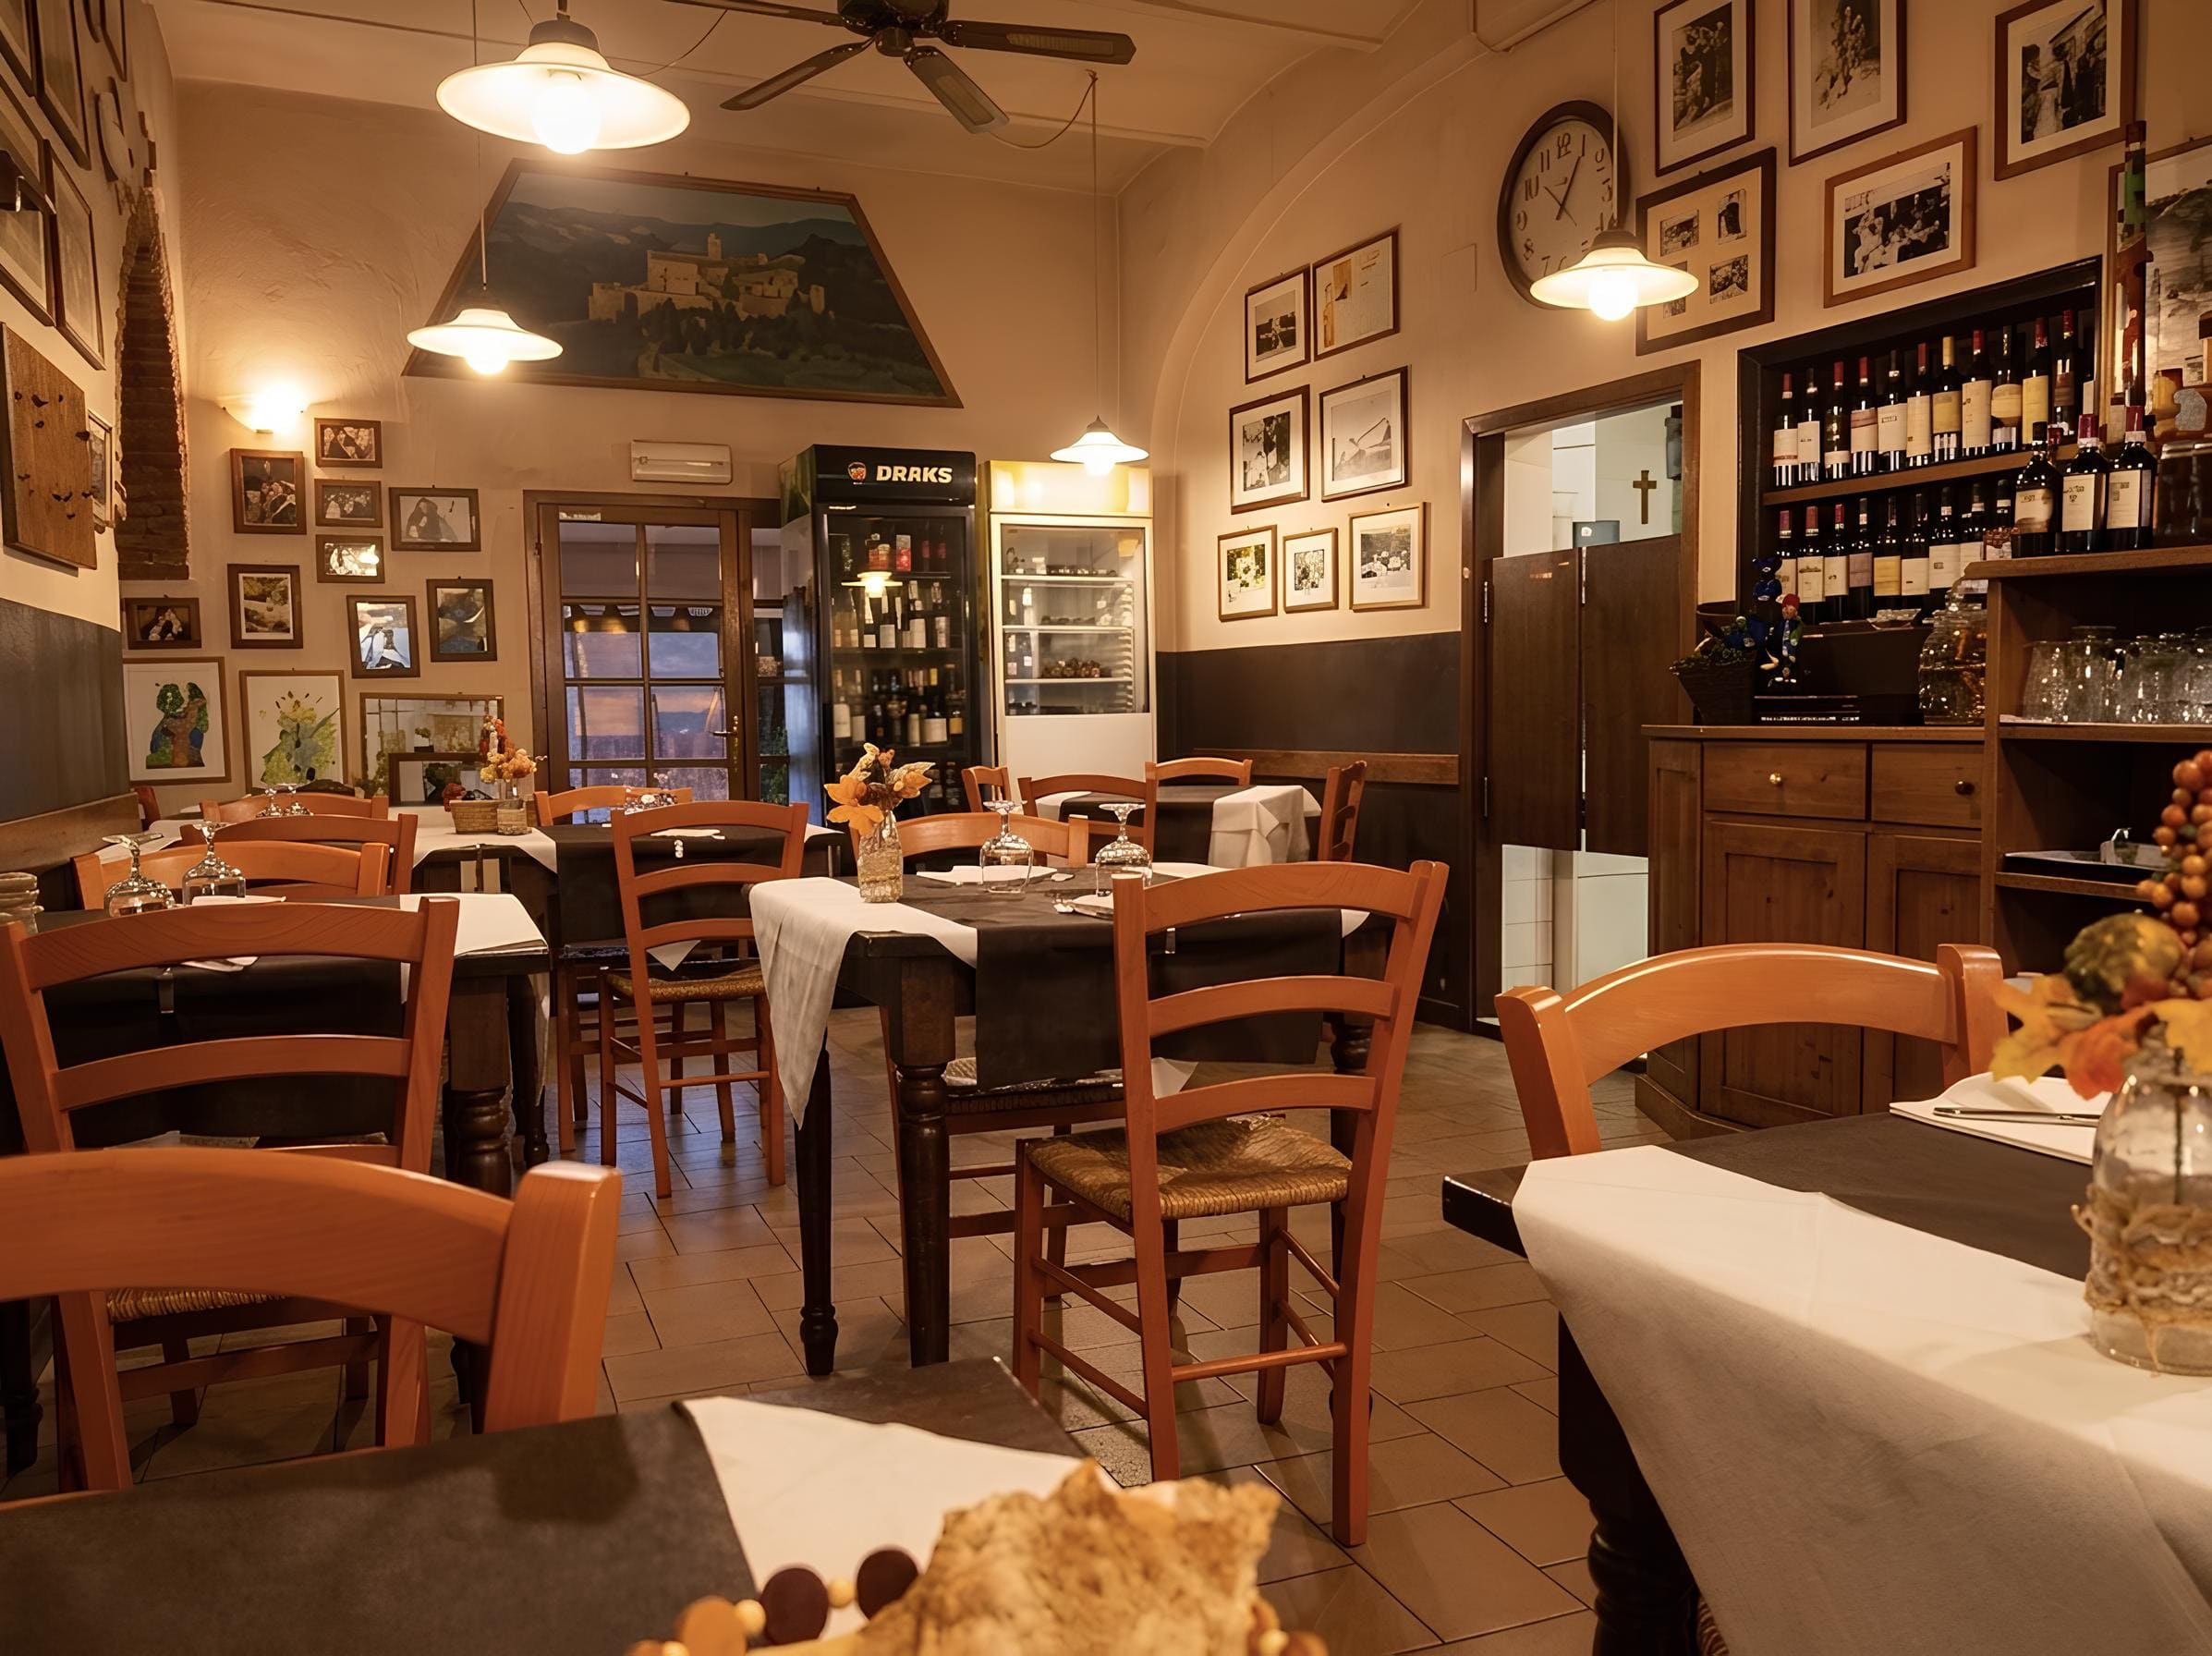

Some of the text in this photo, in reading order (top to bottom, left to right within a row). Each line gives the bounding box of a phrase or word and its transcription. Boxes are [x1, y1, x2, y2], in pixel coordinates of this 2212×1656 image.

[1539, 149, 1550, 173] 11
[1525, 175, 1539, 201] 10
[1523, 237, 1535, 262] 8
[1541, 255, 1551, 277] 7
[876, 465, 953, 483] DRAKS
